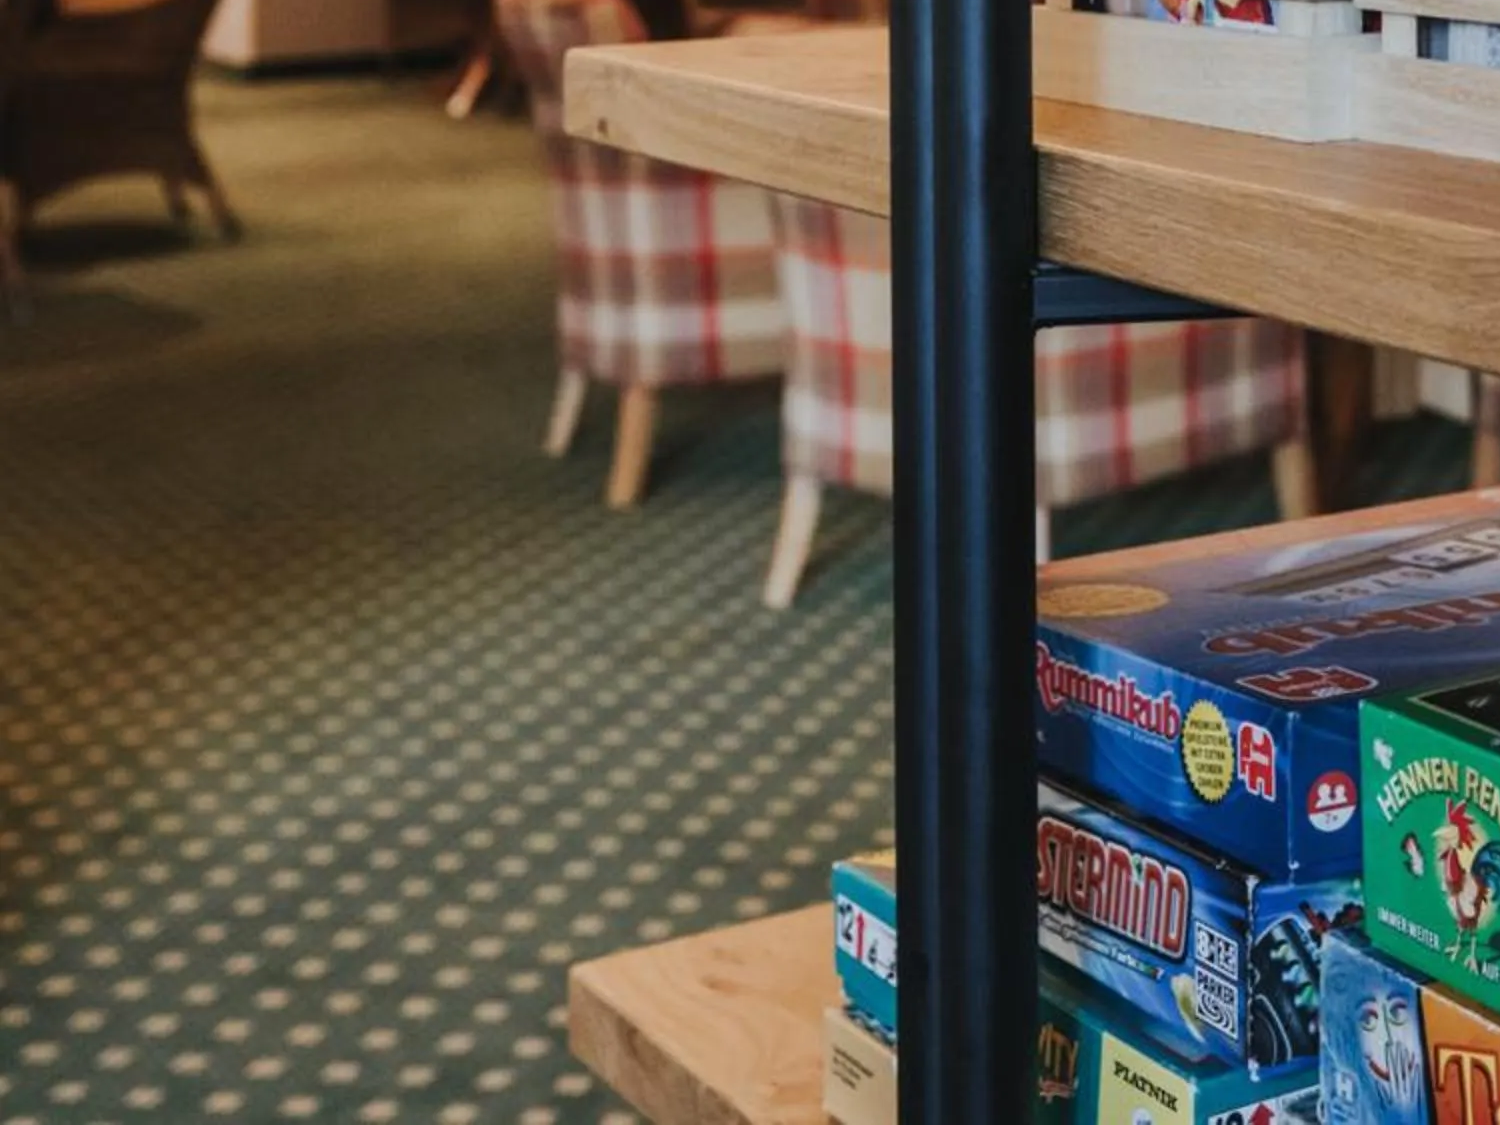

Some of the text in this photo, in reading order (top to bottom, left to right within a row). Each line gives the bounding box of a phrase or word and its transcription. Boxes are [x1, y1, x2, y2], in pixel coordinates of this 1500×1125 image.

[1375, 757, 1460, 822] HENNEN
[1037, 815, 1190, 959] STERMIND
[1376, 906, 1441, 951] IMMER WEITER
[1481, 961, 1500, 983] AUF
[1113, 1060, 1178, 1113] PLATNIK
